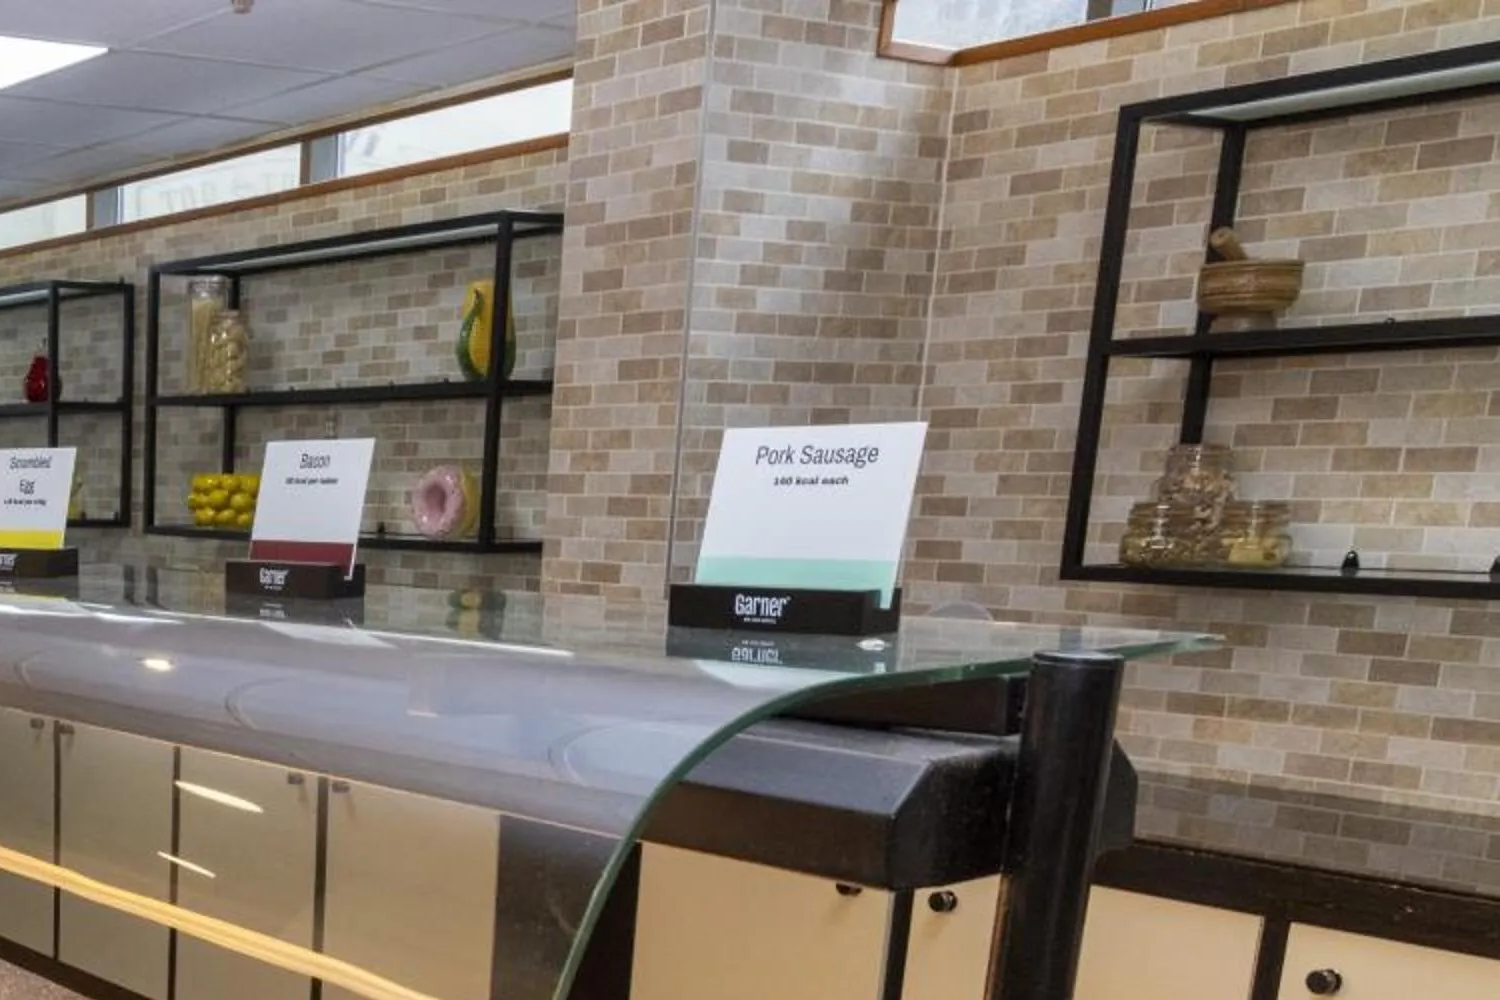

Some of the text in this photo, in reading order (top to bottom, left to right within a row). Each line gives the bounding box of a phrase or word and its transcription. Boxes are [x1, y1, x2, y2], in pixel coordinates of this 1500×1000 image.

[755, 444, 879, 469] Pork Sausage
[734, 593, 788, 617] Garner
